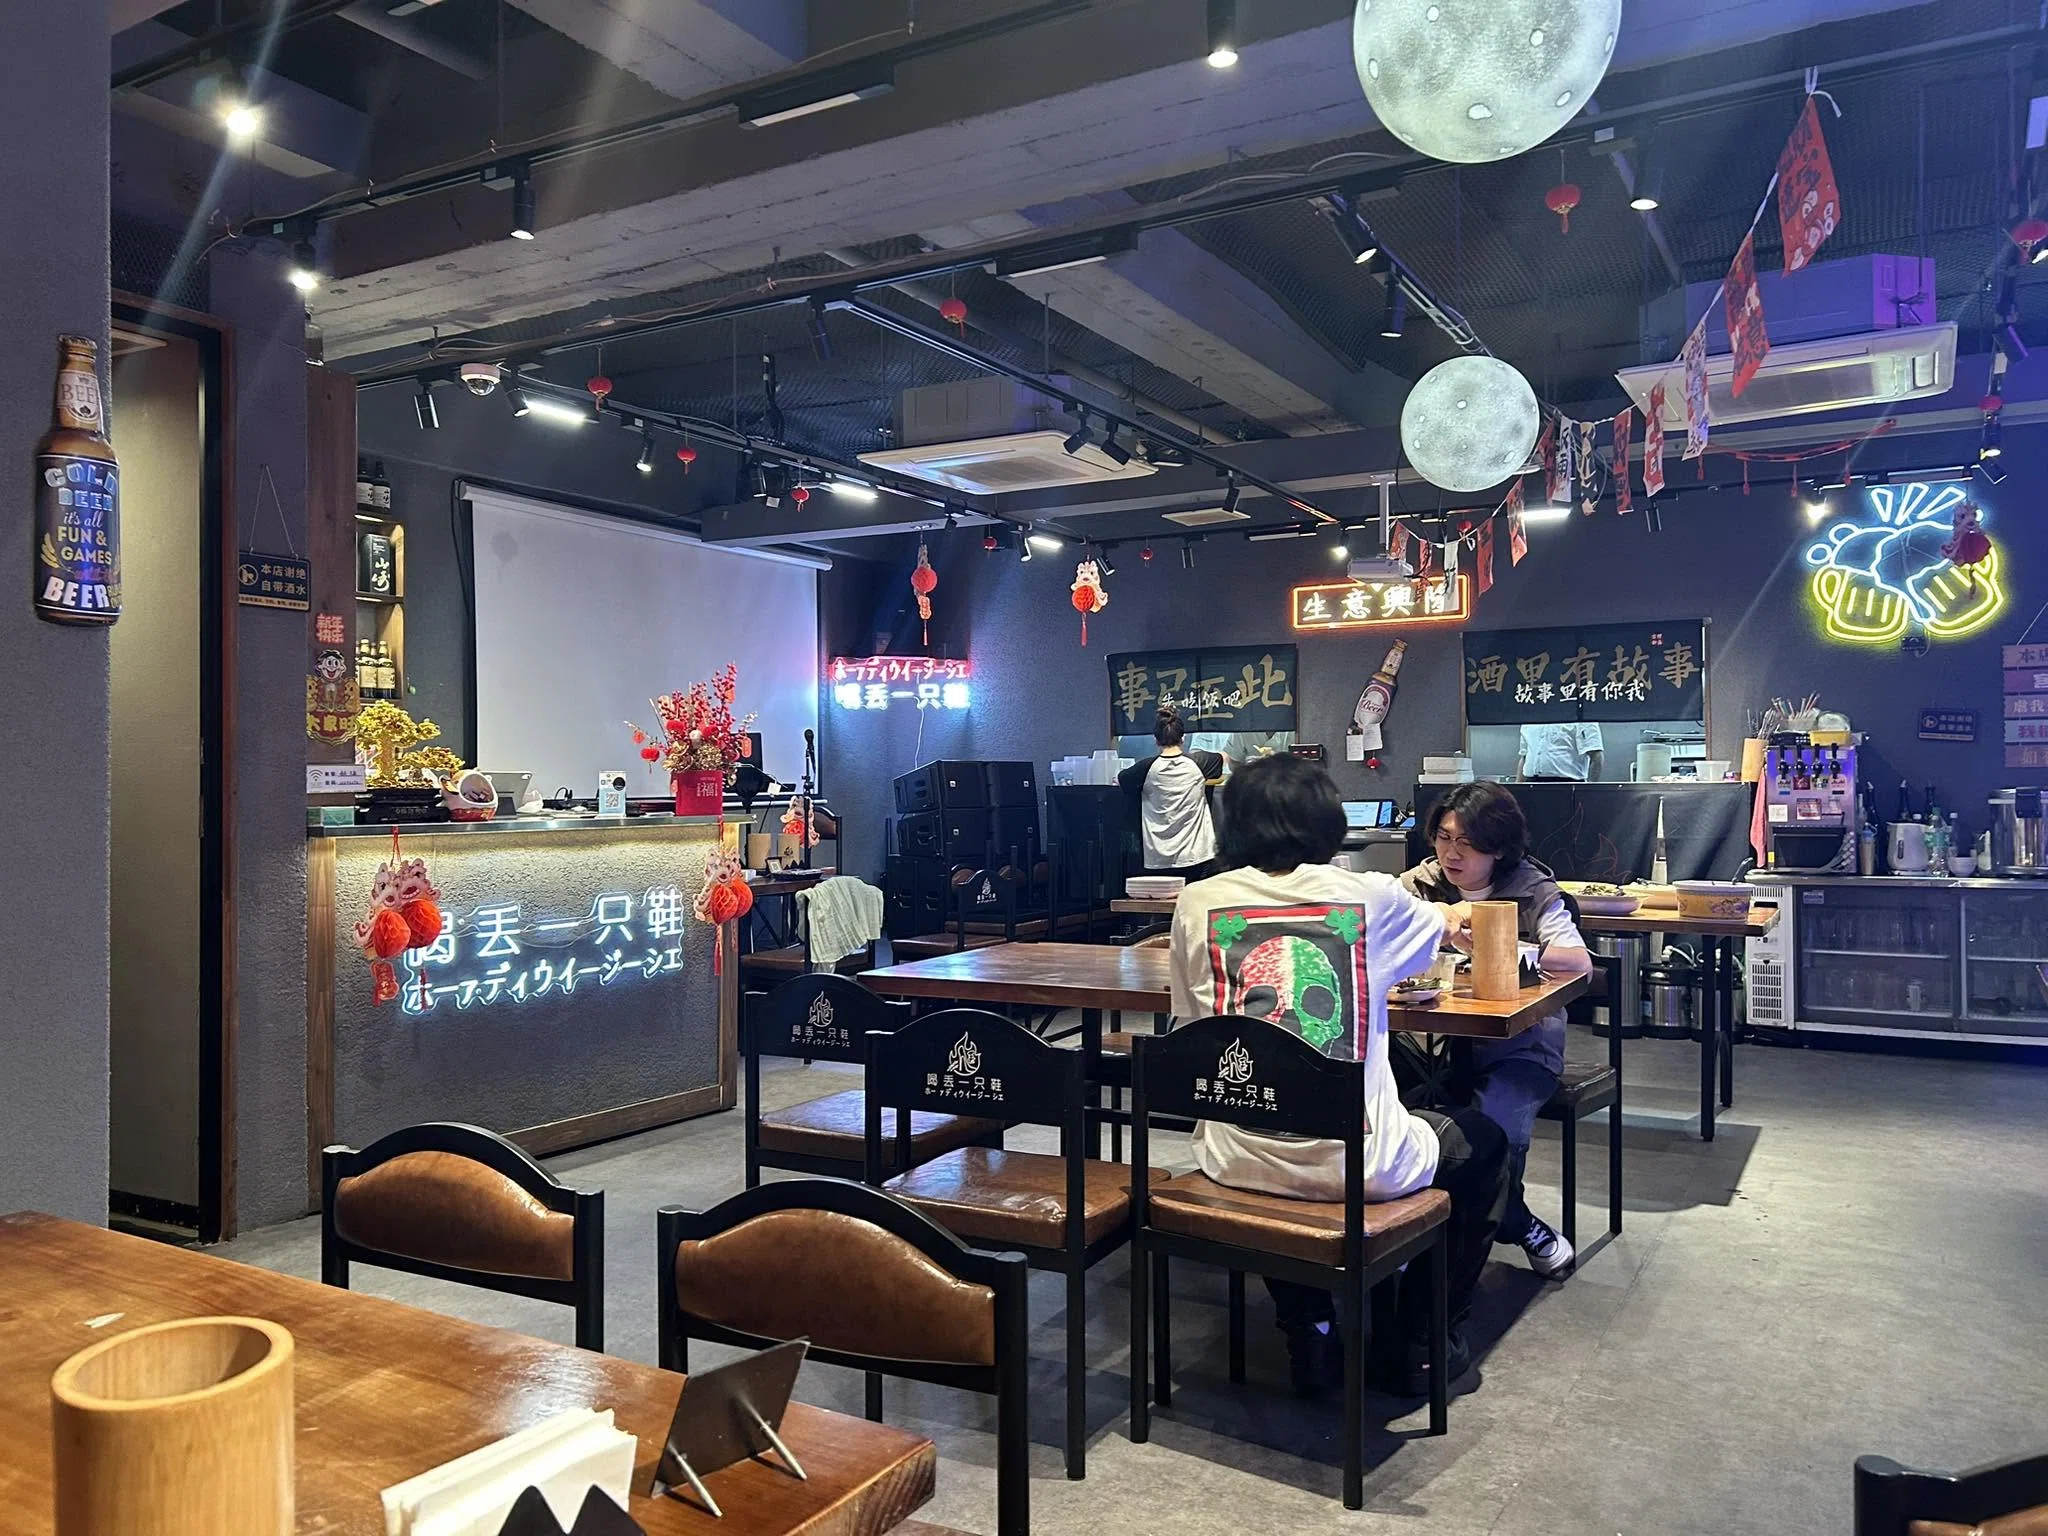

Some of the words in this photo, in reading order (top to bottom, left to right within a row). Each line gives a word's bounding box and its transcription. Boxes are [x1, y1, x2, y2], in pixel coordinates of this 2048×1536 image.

[45, 463, 117, 495] COLD
[58, 487, 112, 511] BEER
[63, 512, 81, 526] it's
[84, 511, 104, 527] all
[57, 526, 92, 544] FUN
[96, 531, 108, 547] &
[61, 547, 112, 565] GAMES
[43, 576, 110, 608] BEER
[261, 580, 306, 595] 自带酒水
[1467, 642, 1700, 693] 酒里有故事
[1514, 679, 1645, 704] 故事里有你我
[1361, 699, 1384, 713] Beer
